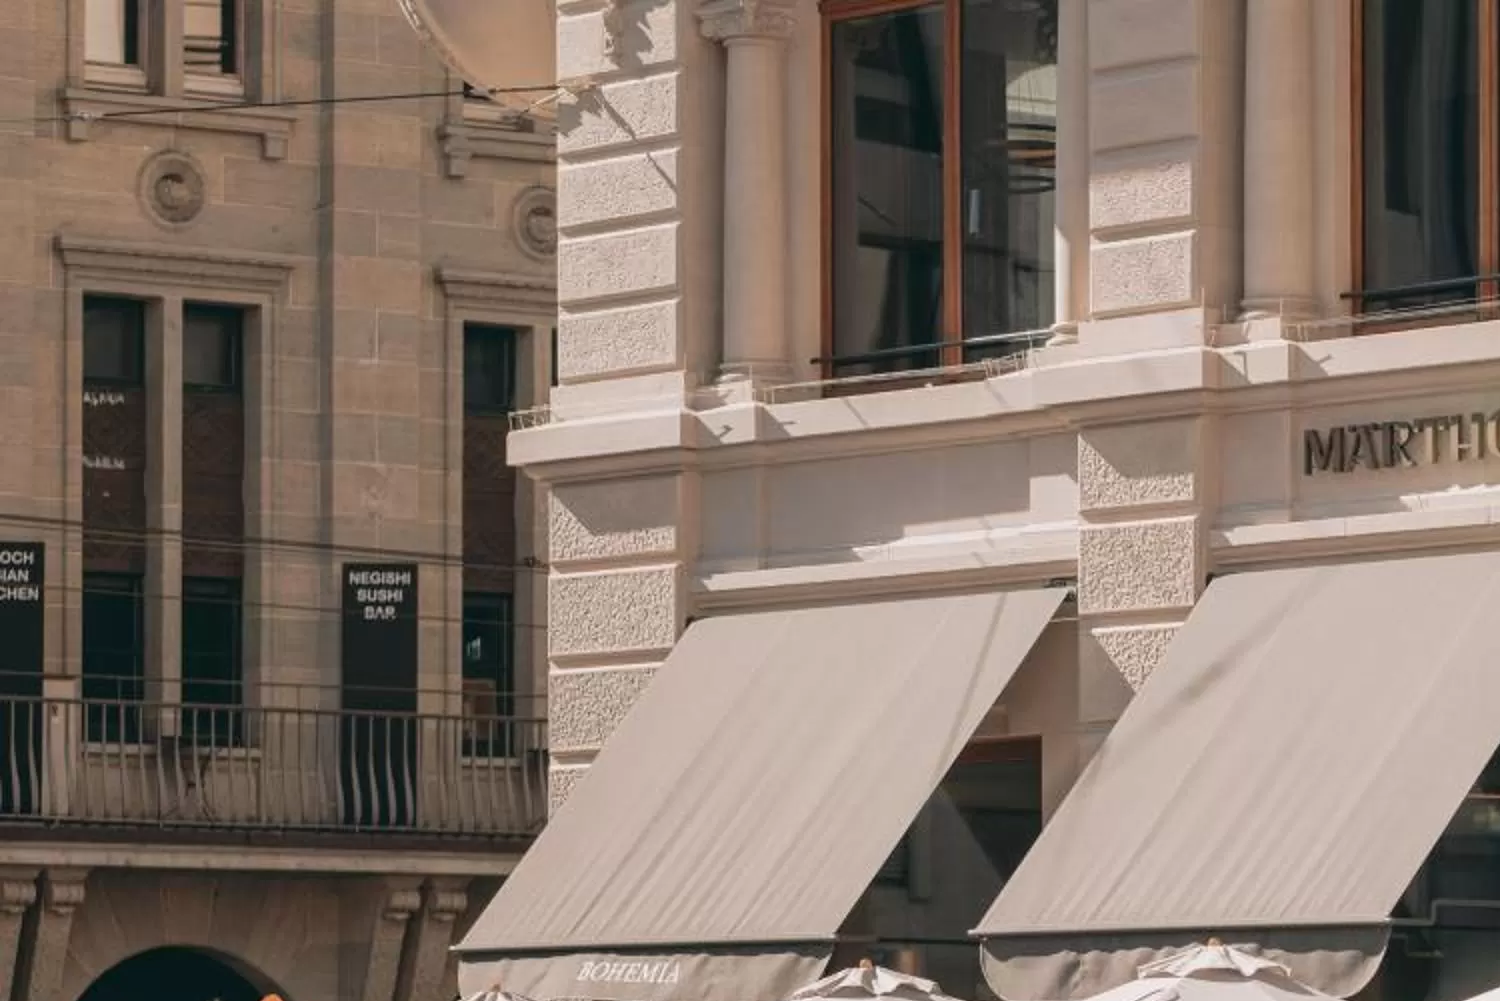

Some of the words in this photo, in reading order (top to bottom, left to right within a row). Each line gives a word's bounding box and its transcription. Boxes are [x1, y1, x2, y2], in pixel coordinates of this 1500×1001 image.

[349, 571, 411, 586] NEGISHI
[357, 589, 403, 603] SUSHI
[364, 605, 397, 620] BAR
[576, 960, 681, 984] BOHEMIA
